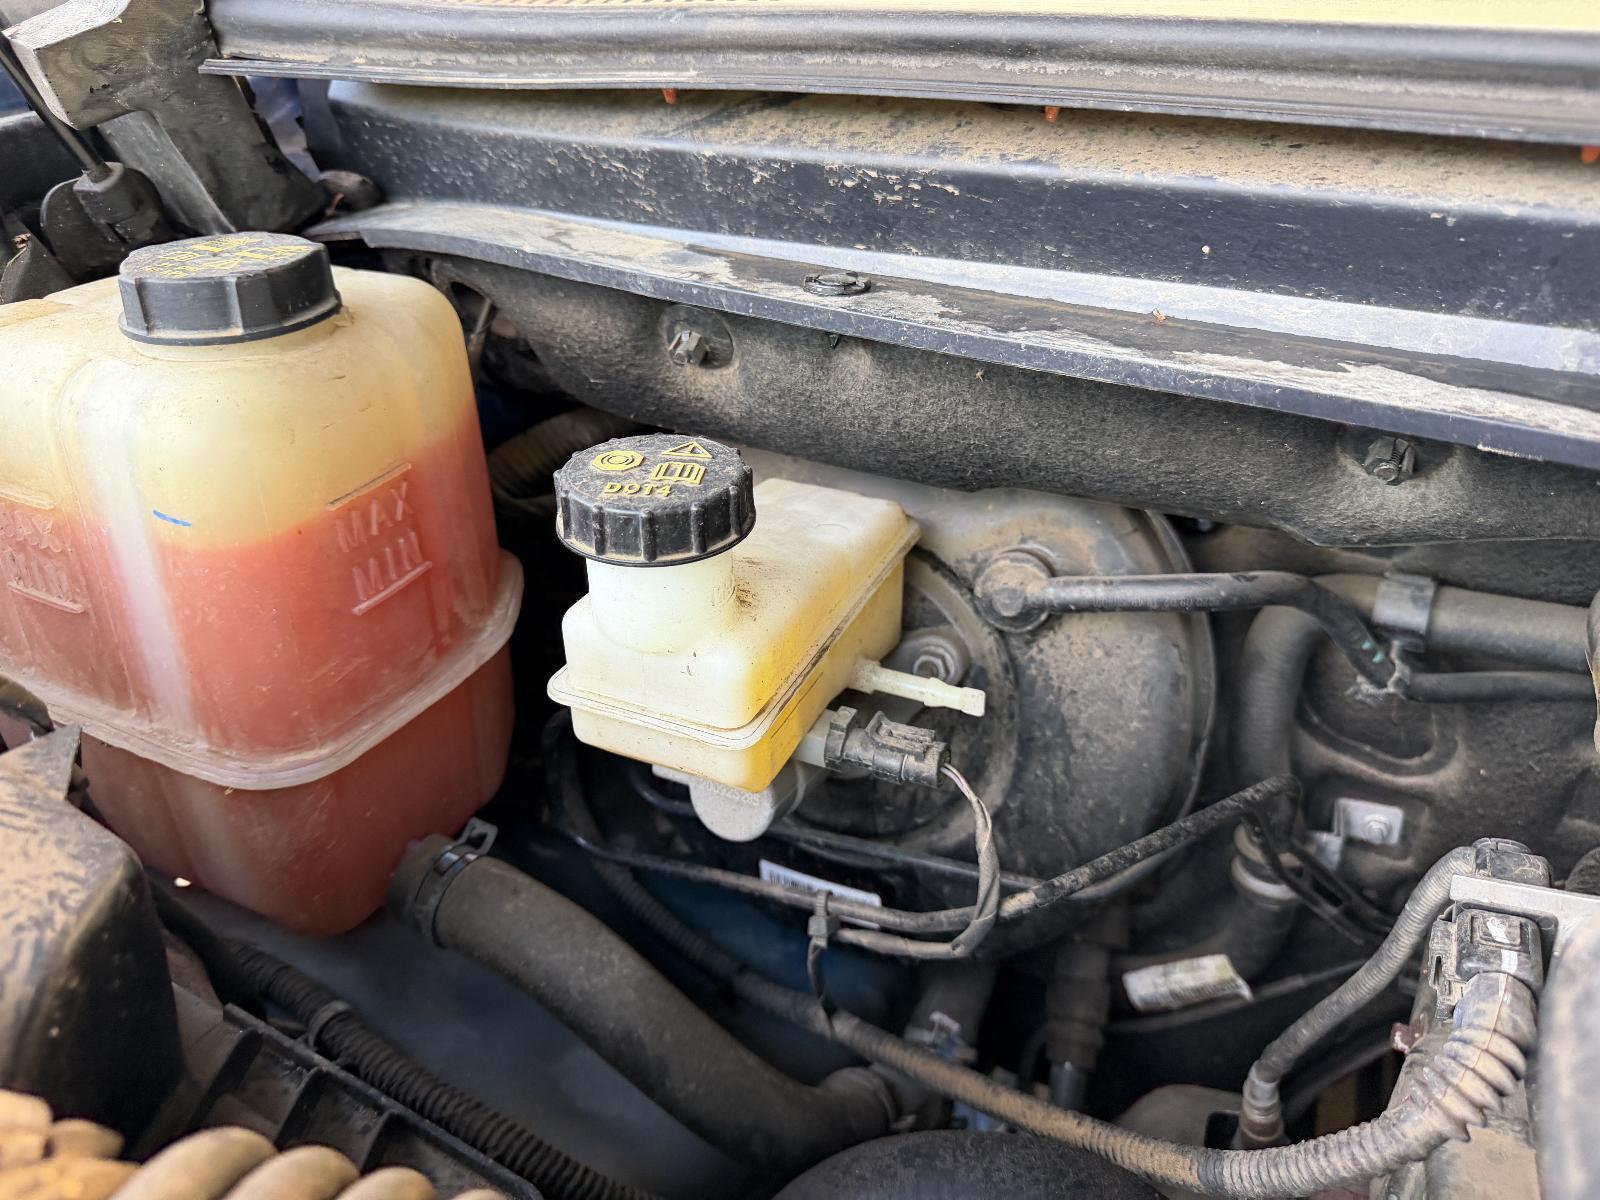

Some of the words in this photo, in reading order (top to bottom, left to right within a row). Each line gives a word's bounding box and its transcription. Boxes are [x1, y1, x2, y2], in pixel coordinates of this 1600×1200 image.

[335, 480, 415, 552] MAX
[603, 481, 672, 498] DOT4
[351, 527, 424, 601] MIN
